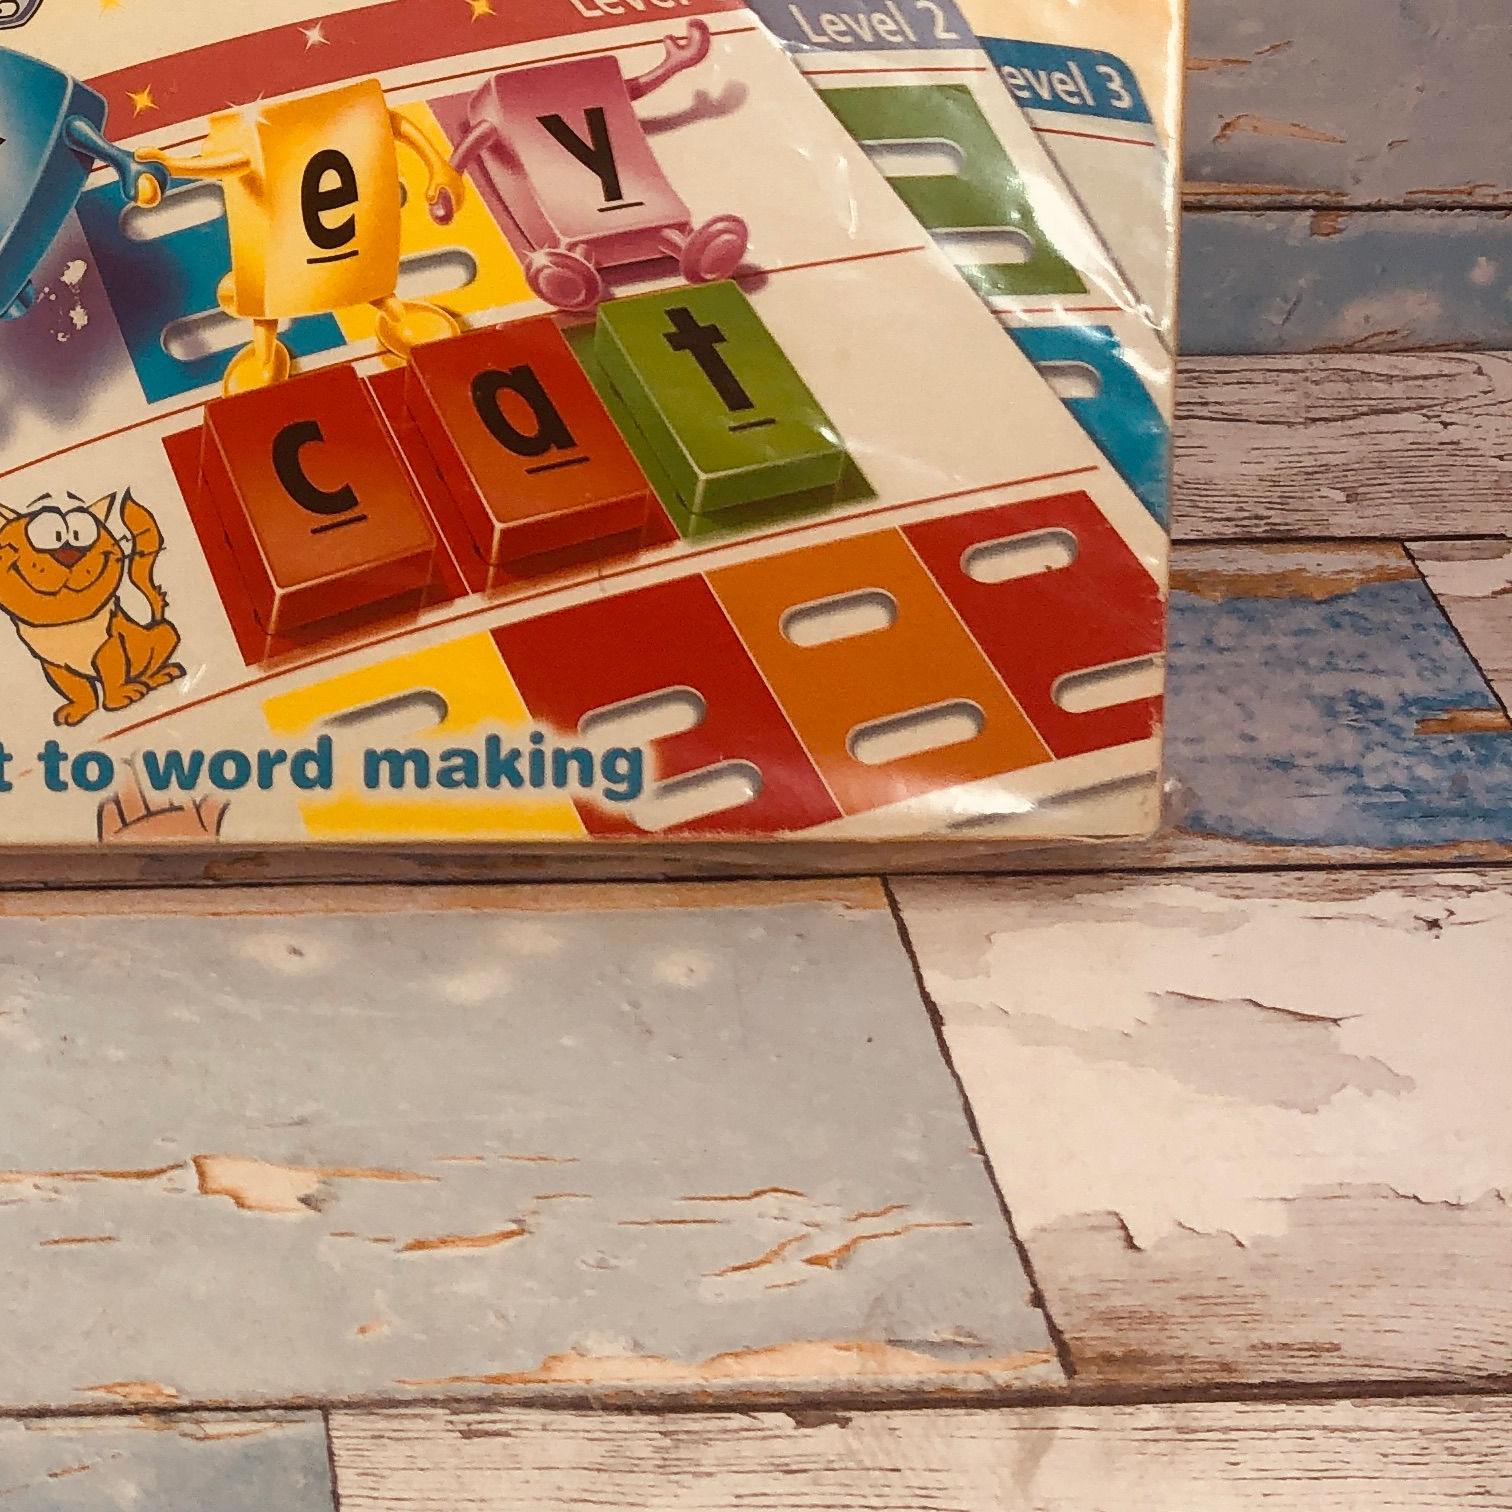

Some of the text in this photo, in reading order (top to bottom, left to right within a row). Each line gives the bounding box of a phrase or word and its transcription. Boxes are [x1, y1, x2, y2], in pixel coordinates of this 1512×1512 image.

[916, 0, 959, 41] 2
[1003, 60, 1135, 110] evel 3
[37, 739, 115, 792] to
[141, 733, 334, 791] word
[363, 731, 644, 802] making
